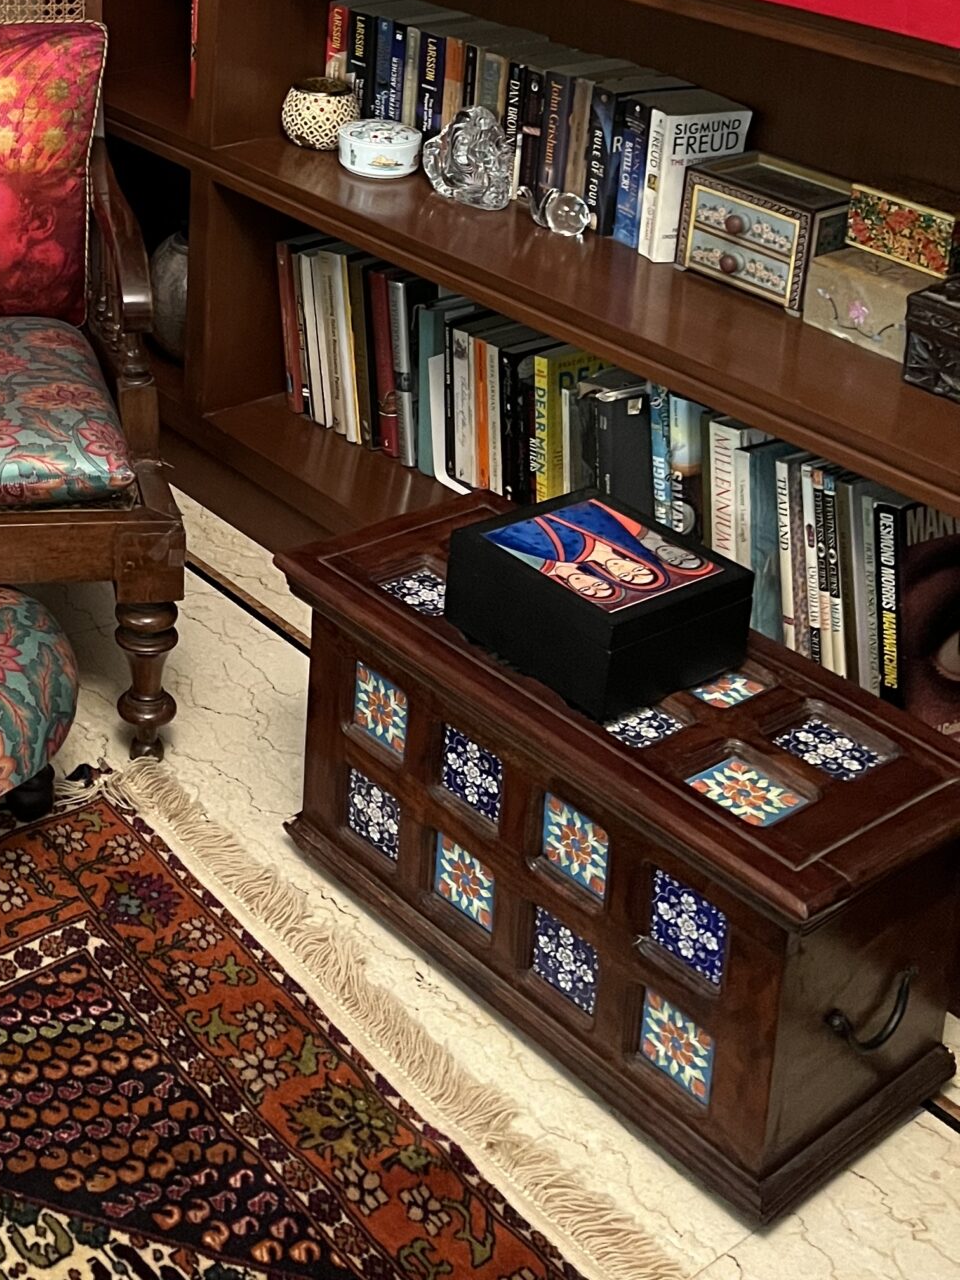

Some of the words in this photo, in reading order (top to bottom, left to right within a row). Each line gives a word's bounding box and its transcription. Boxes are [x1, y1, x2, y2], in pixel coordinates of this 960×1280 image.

[331, 8, 343, 49] LARSSON
[355, 16, 366, 57] LARSSON
[425, 38, 437, 81] LARSSON
[509, 79, 520, 107] DAN
[550, 81, 563, 112] John
[506, 107, 519, 145] BROWN
[545, 114, 559, 163] Grisham
[593, 129, 603, 158] RULE
[672, 131, 739, 156] FREUD
[674, 119, 742, 136] SIGMUND
[591, 160, 600, 173] OF
[622, 141, 633, 172] BATTLE
[650, 130, 660, 168] FREUD
[587, 178, 599, 207] FOUR
[621, 173, 630, 192] CRY
[535, 386, 546, 431] DEAR
[529, 437, 540, 472] KITTENS
[536, 437, 546, 475] MEN
[652, 455, 666, 501] GOGH
[714, 431, 732, 552] MILLENNIUM
[671, 470, 684, 533] SALVAD
[777, 476, 790, 551] THAILAND
[824, 496, 835, 549] EYEWITNESS
[879, 512, 894, 565] DESMOND
[818, 557, 827, 591] GUIDES
[829, 564, 838, 597] GUIDES
[881, 566, 896, 611] MORRIS
[831, 602, 841, 633] MEDIA
[882, 611, 898, 689] MANWATCHING
